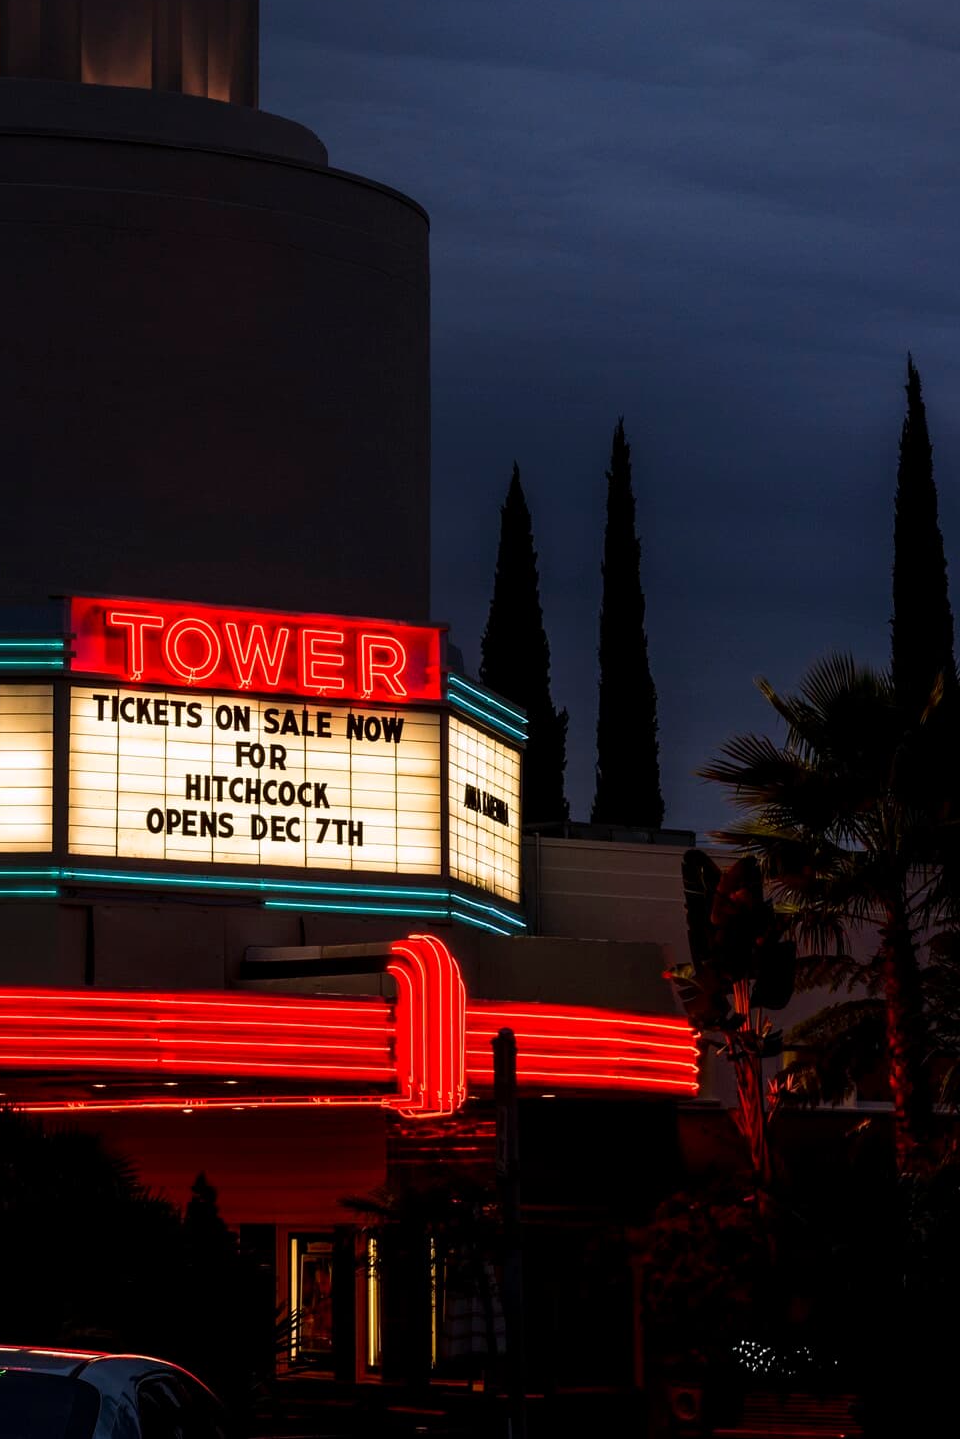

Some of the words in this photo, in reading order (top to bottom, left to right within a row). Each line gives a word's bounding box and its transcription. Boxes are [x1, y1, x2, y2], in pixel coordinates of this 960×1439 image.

[109, 611, 407, 698] TOWER
[93, 694, 203, 729] TICKETS
[215, 704, 251, 732] ON
[263, 708, 332, 739] SALE
[346, 714, 405, 744] NOW
[235, 741, 288, 771] FOR
[185, 774, 330, 809] HITCHCOCK
[146, 808, 234, 839] OPENS
[250, 814, 301, 843] DEC
[315, 818, 365, 848] 7TH
